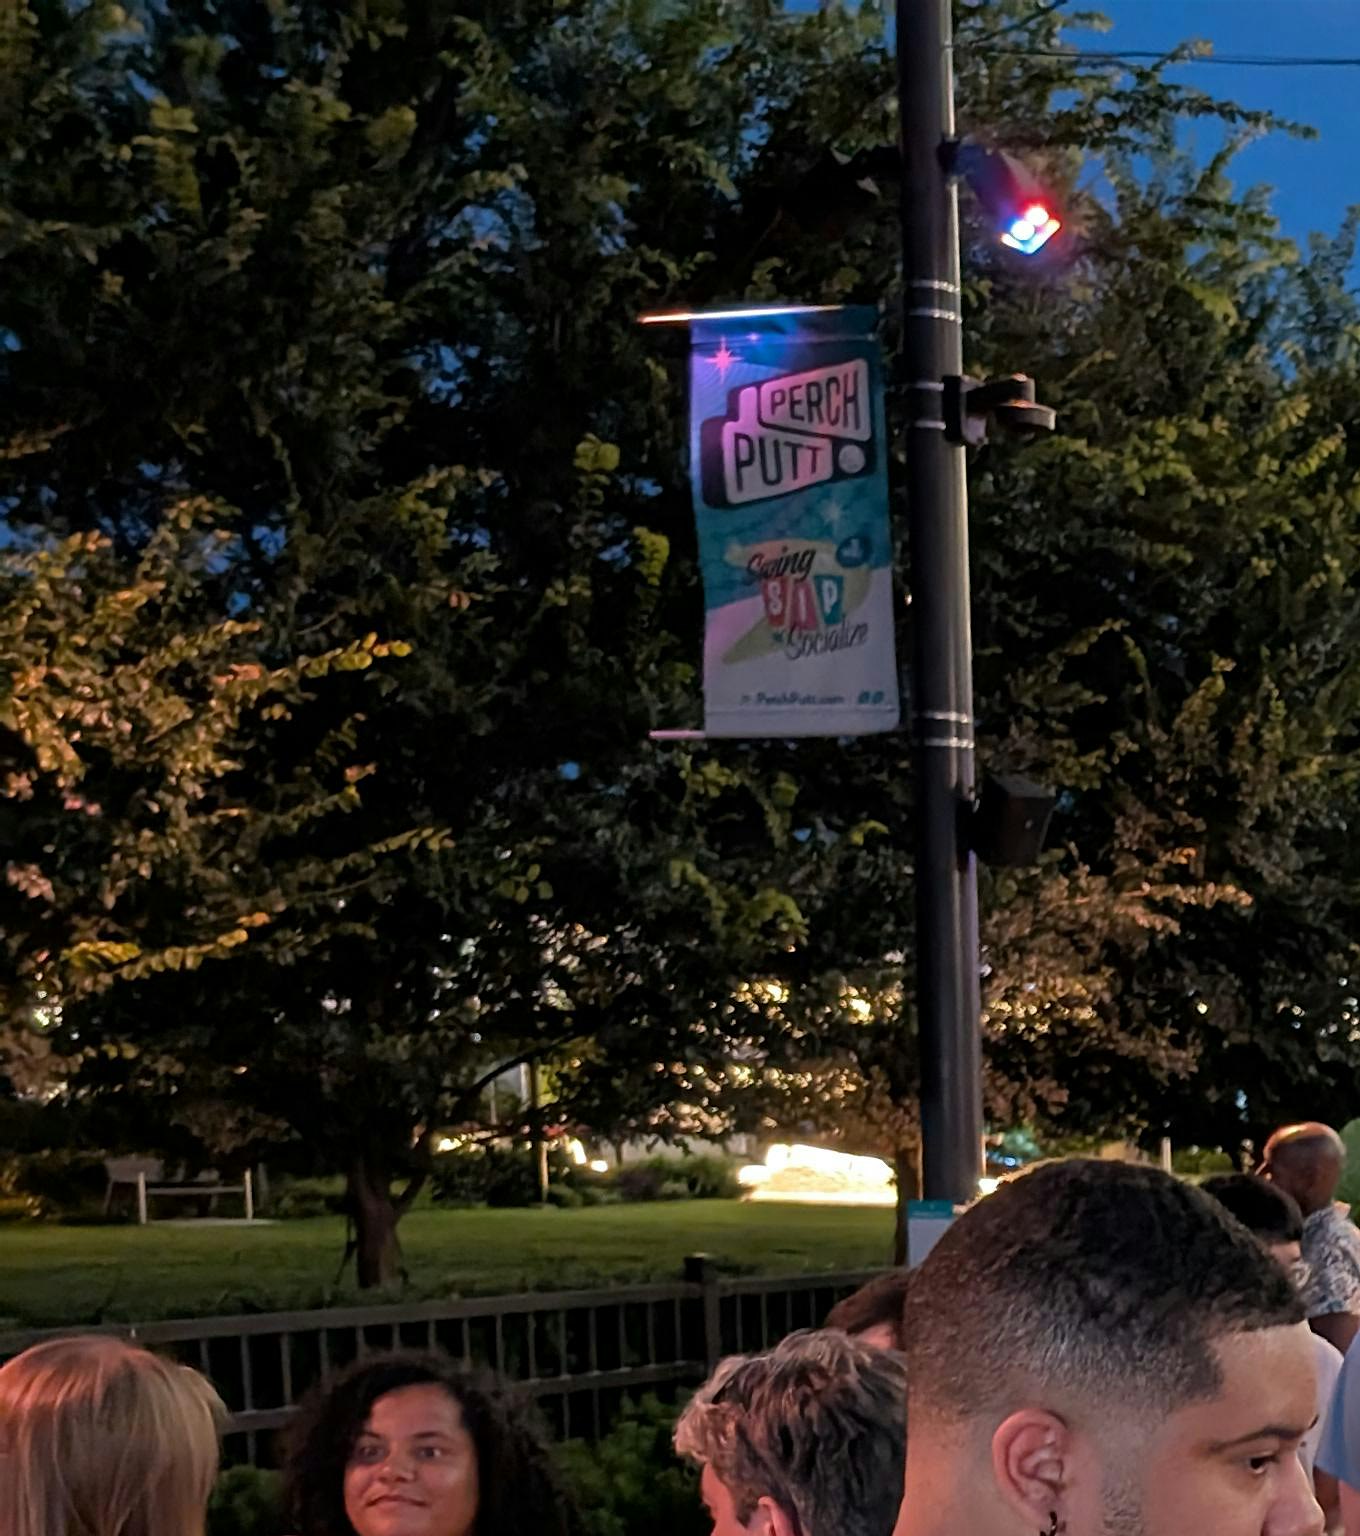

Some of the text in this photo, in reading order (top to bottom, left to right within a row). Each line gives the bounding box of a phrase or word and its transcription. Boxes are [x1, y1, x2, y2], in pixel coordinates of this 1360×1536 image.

[770, 369, 860, 432] PERCH
[733, 431, 823, 493] PUTT
[745, 546, 817, 583] Swing
[767, 578, 838, 622] SIP
